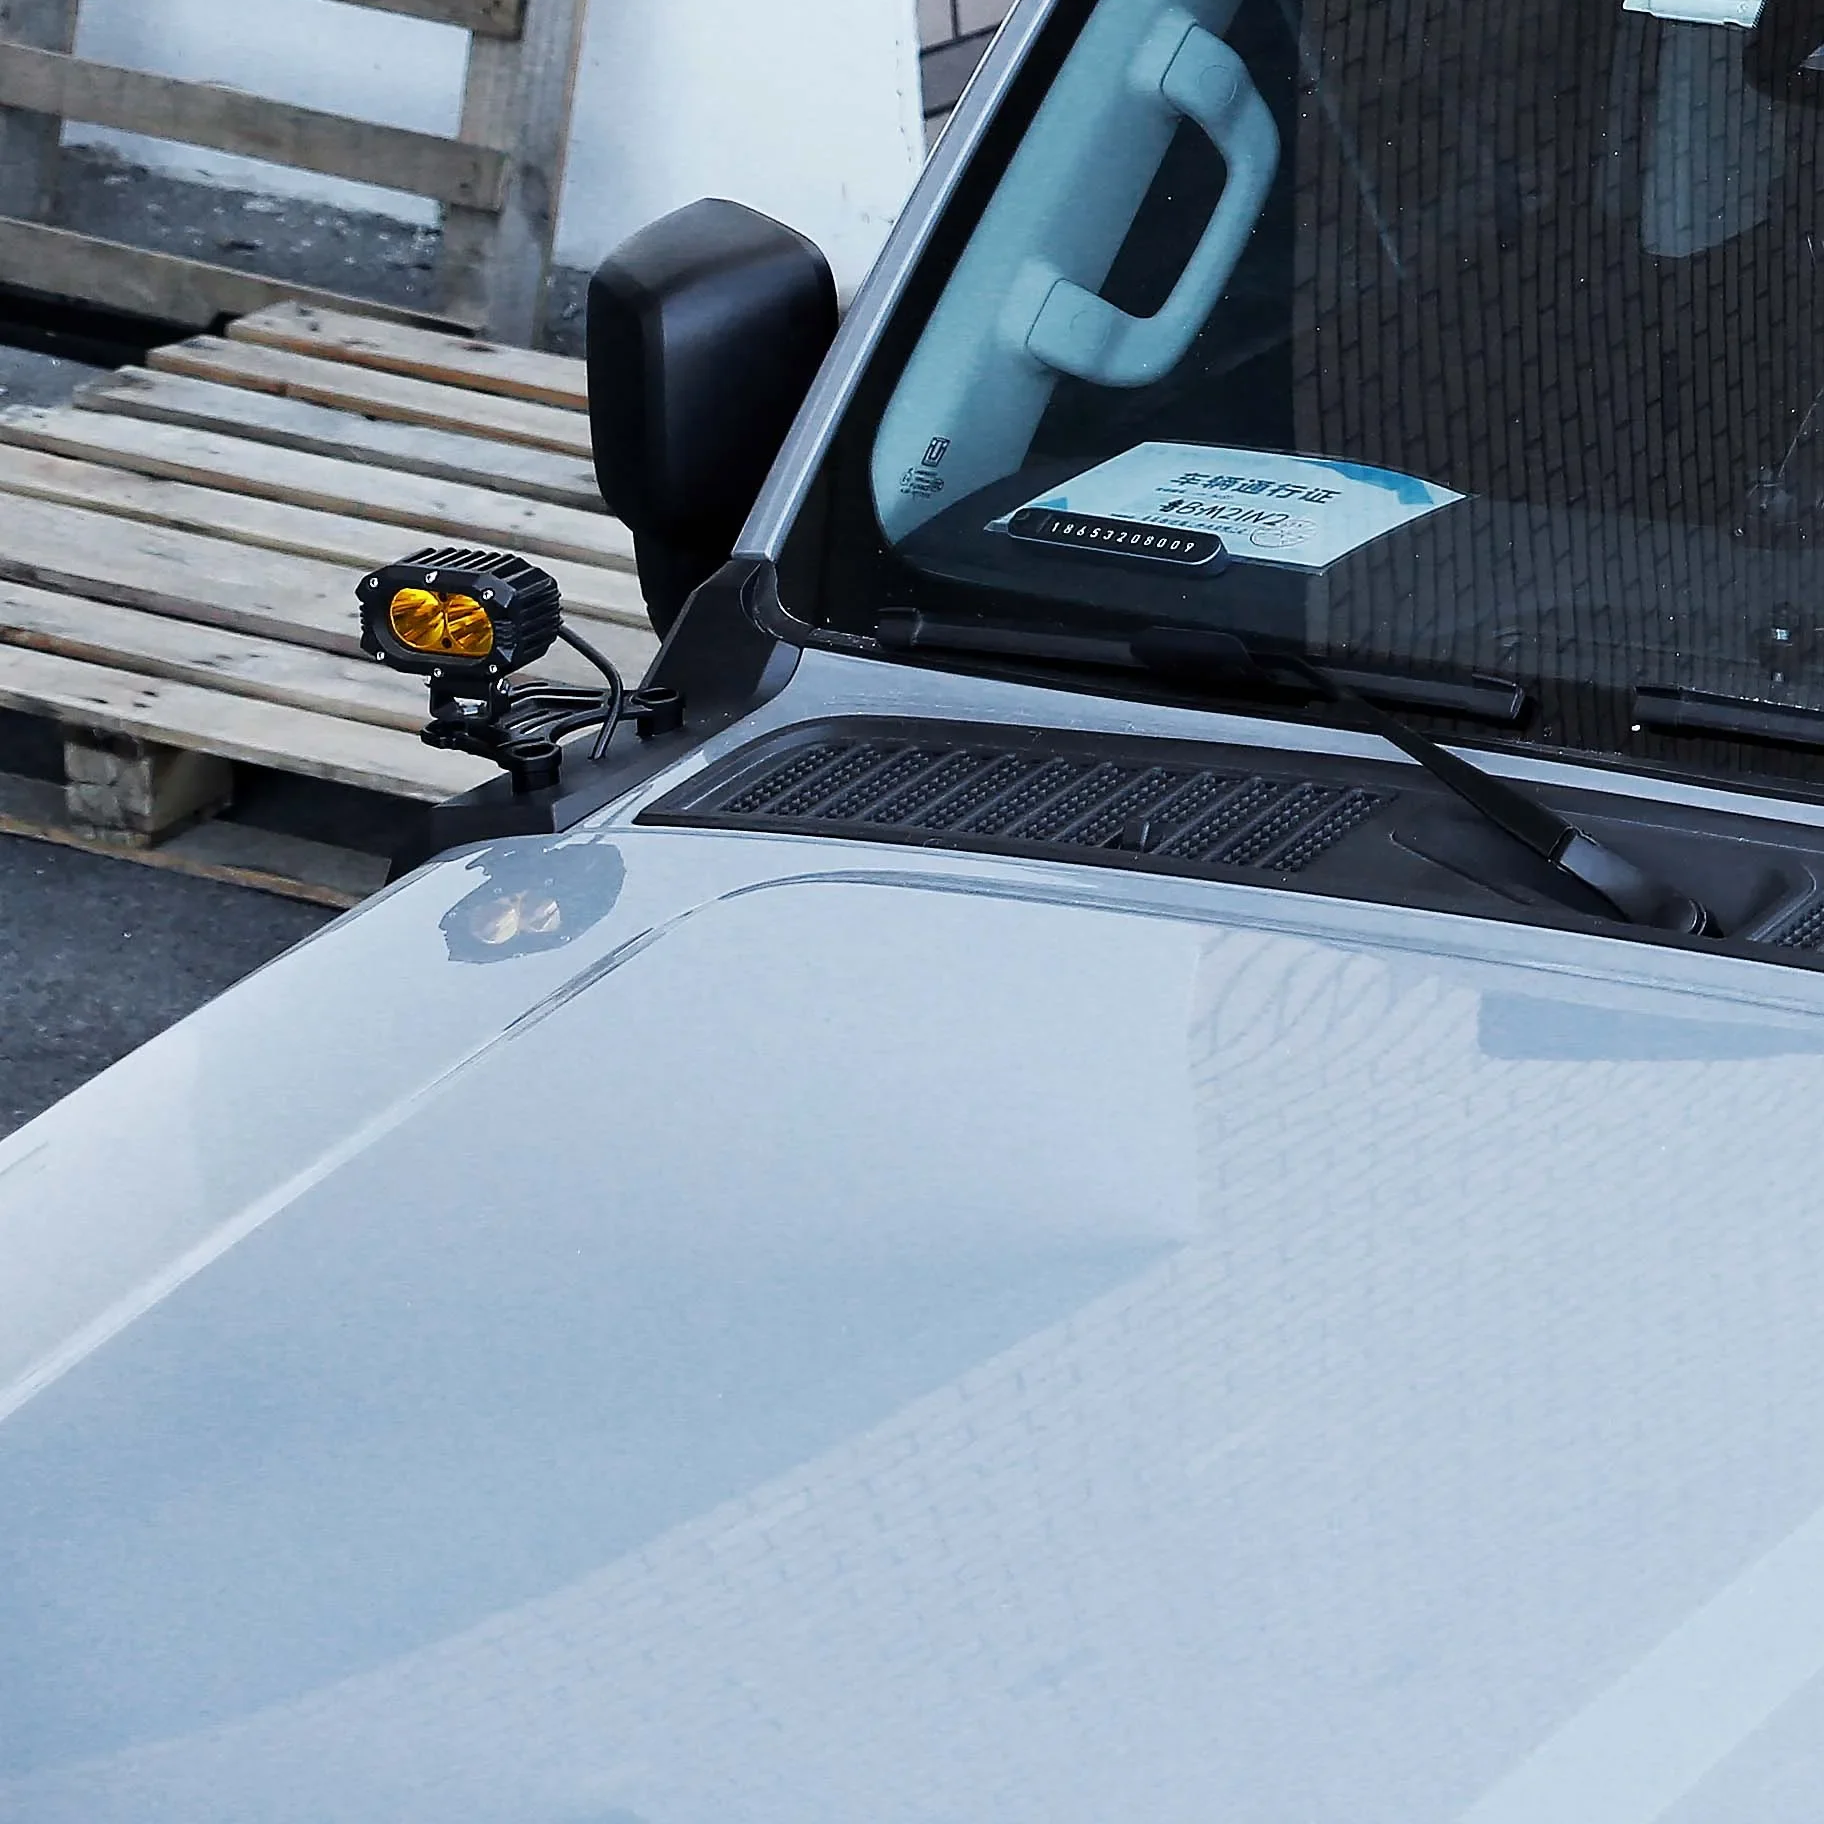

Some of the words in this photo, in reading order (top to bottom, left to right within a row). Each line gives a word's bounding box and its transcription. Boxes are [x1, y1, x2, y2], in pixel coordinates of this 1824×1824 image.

[1171, 472, 1342, 504] 车辆通行证
[1051, 521, 1195, 553] 18653208009
